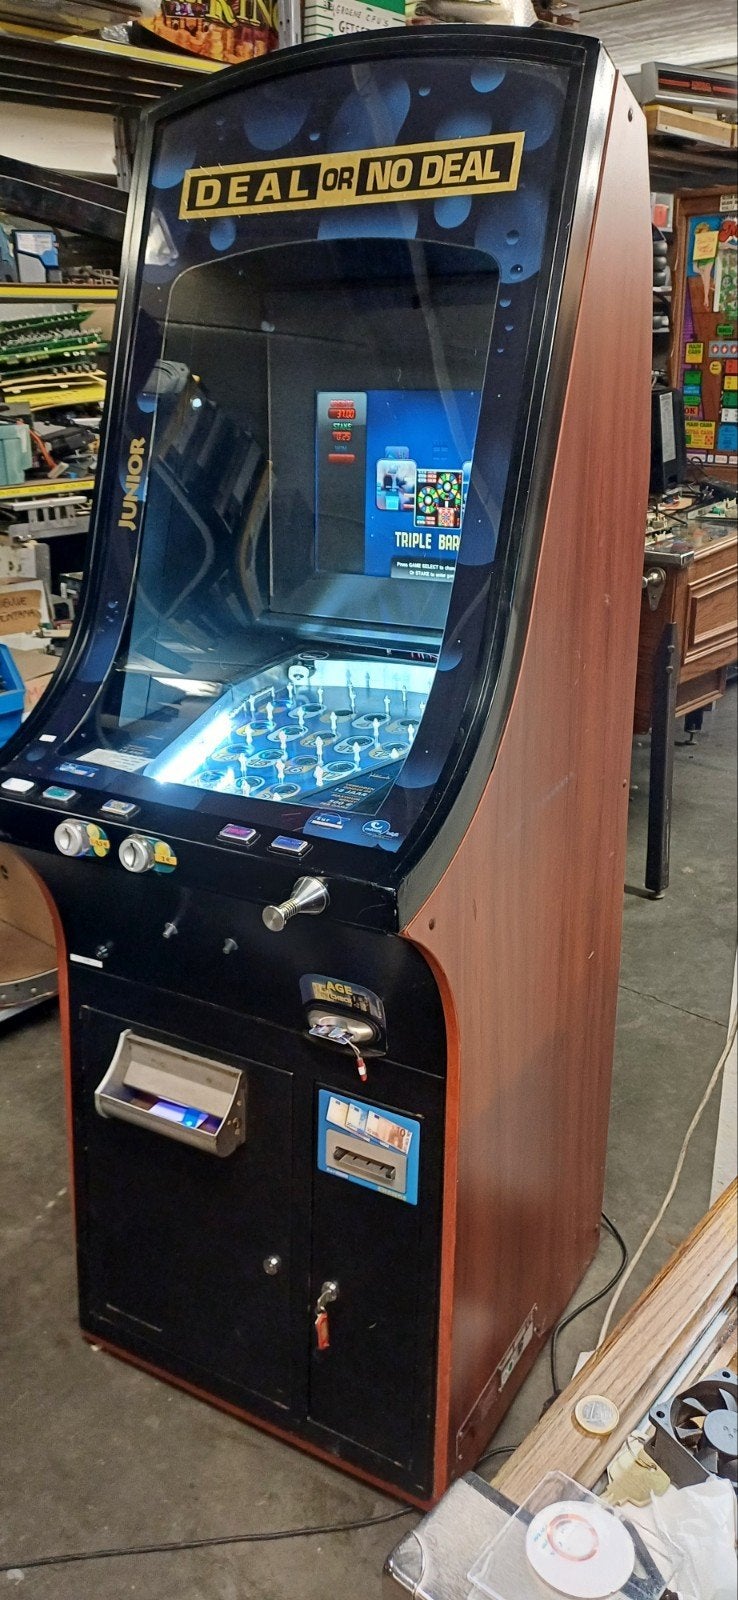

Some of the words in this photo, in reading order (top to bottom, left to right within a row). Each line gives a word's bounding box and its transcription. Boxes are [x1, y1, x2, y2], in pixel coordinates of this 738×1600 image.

[195, 172, 309, 207] DEAL
[321, 166, 354, 191] OR
[366, 158, 413, 192] NO
[419, 148, 500, 187] DEAL
[118, 436, 146, 531] JUNIOR
[395, 531, 432, 550] TRIPLE
[326, 981, 354, 996] AGE
